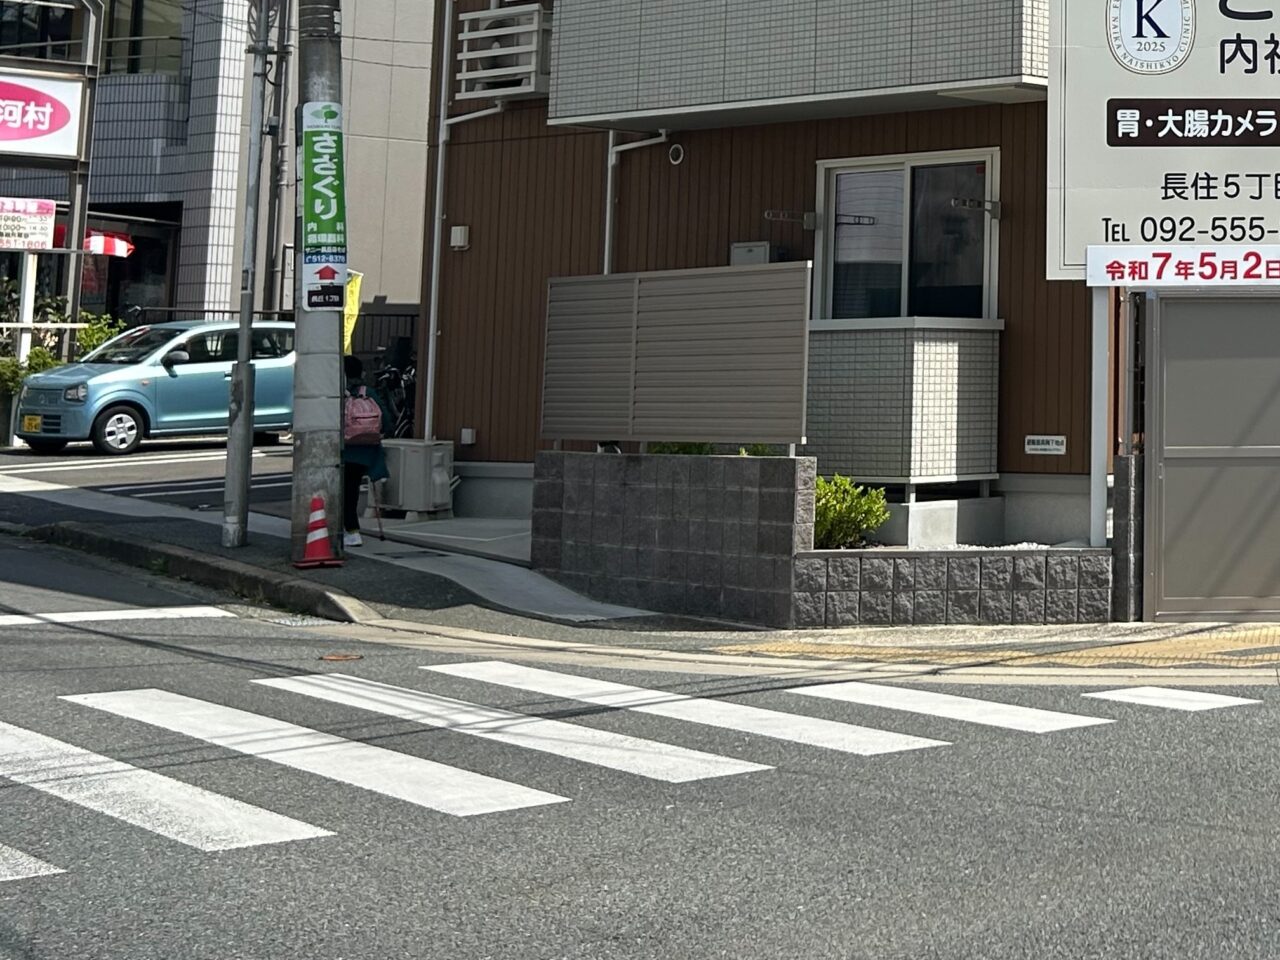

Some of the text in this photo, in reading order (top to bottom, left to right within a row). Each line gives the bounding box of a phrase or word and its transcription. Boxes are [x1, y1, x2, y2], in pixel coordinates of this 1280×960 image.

[1136, 41, 1166, 52] 2025
[1115, 107, 1279, 139] 胃・大腸カメラ
